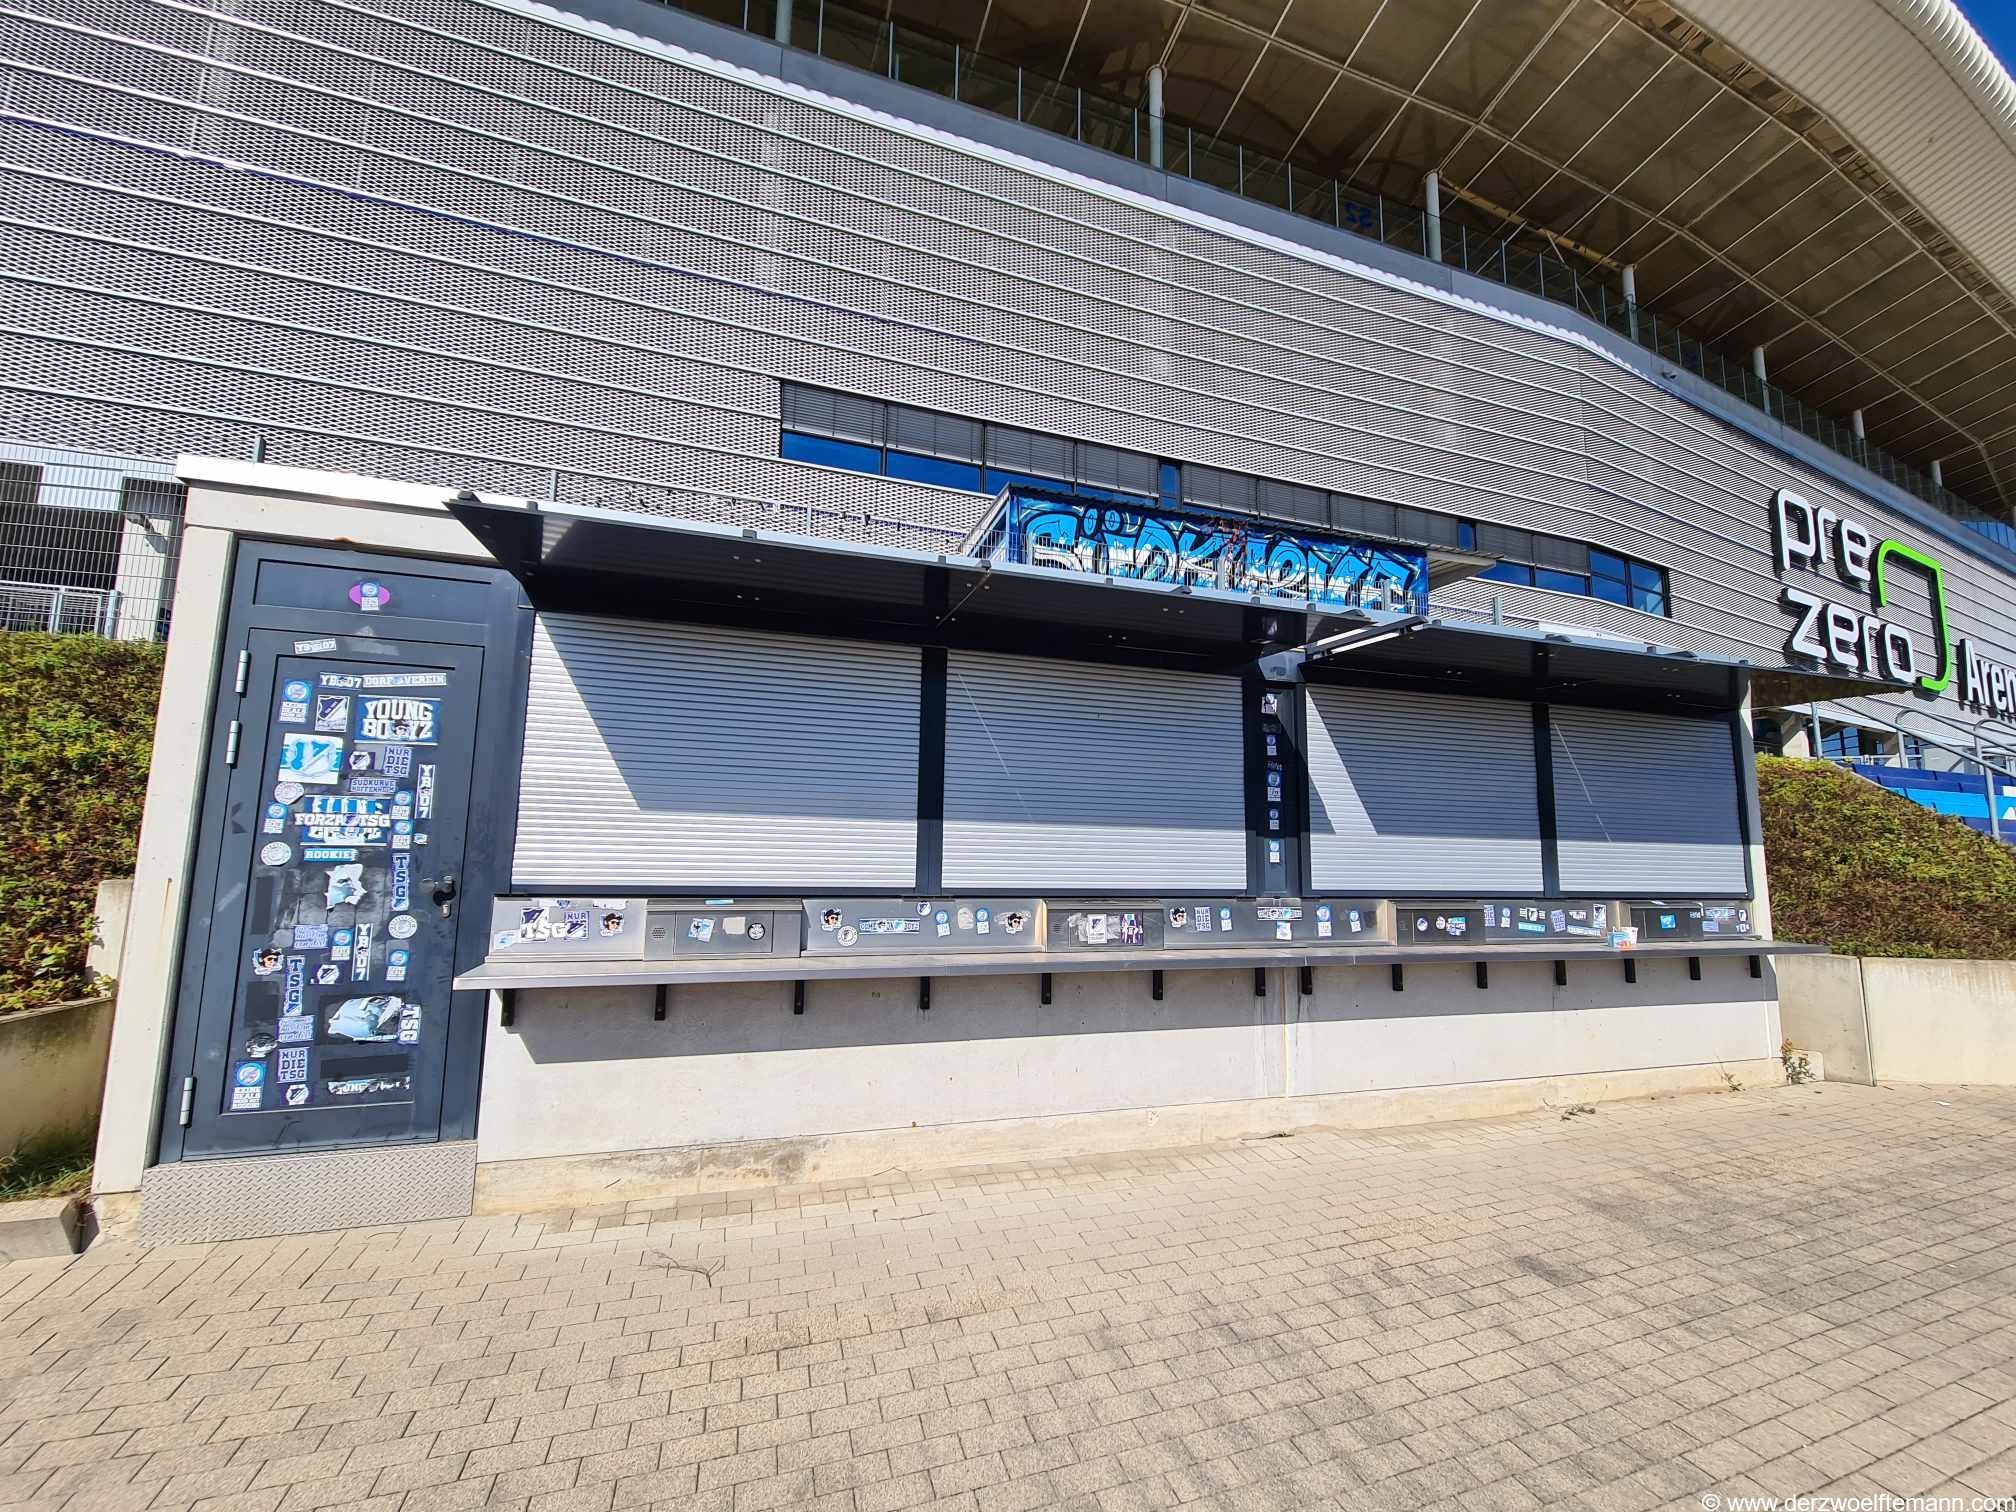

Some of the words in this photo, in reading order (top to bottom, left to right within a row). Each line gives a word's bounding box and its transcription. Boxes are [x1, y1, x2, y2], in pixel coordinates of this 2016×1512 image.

[1776, 487, 1871, 583] pre
[1784, 587, 1917, 684] zero
[364, 699, 433, 720] YOUNG
[361, 718, 433, 740] BOYZ
[388, 748, 410, 756] NUR
[387, 756, 409, 766] DIE
[385, 765, 407, 775] TSG
[294, 813, 344, 826] FORZA
[358, 814, 391, 827] TSG
[395, 856, 407, 898] TSG
[567, 912, 587, 920] NUR
[288, 959, 302, 1002] TSG
[401, 1005, 421, 1041] TSG
[282, 1050, 305, 1059] NUR
[281, 1059, 305, 1070] DIE
[280, 1069, 305, 1080] TSG
